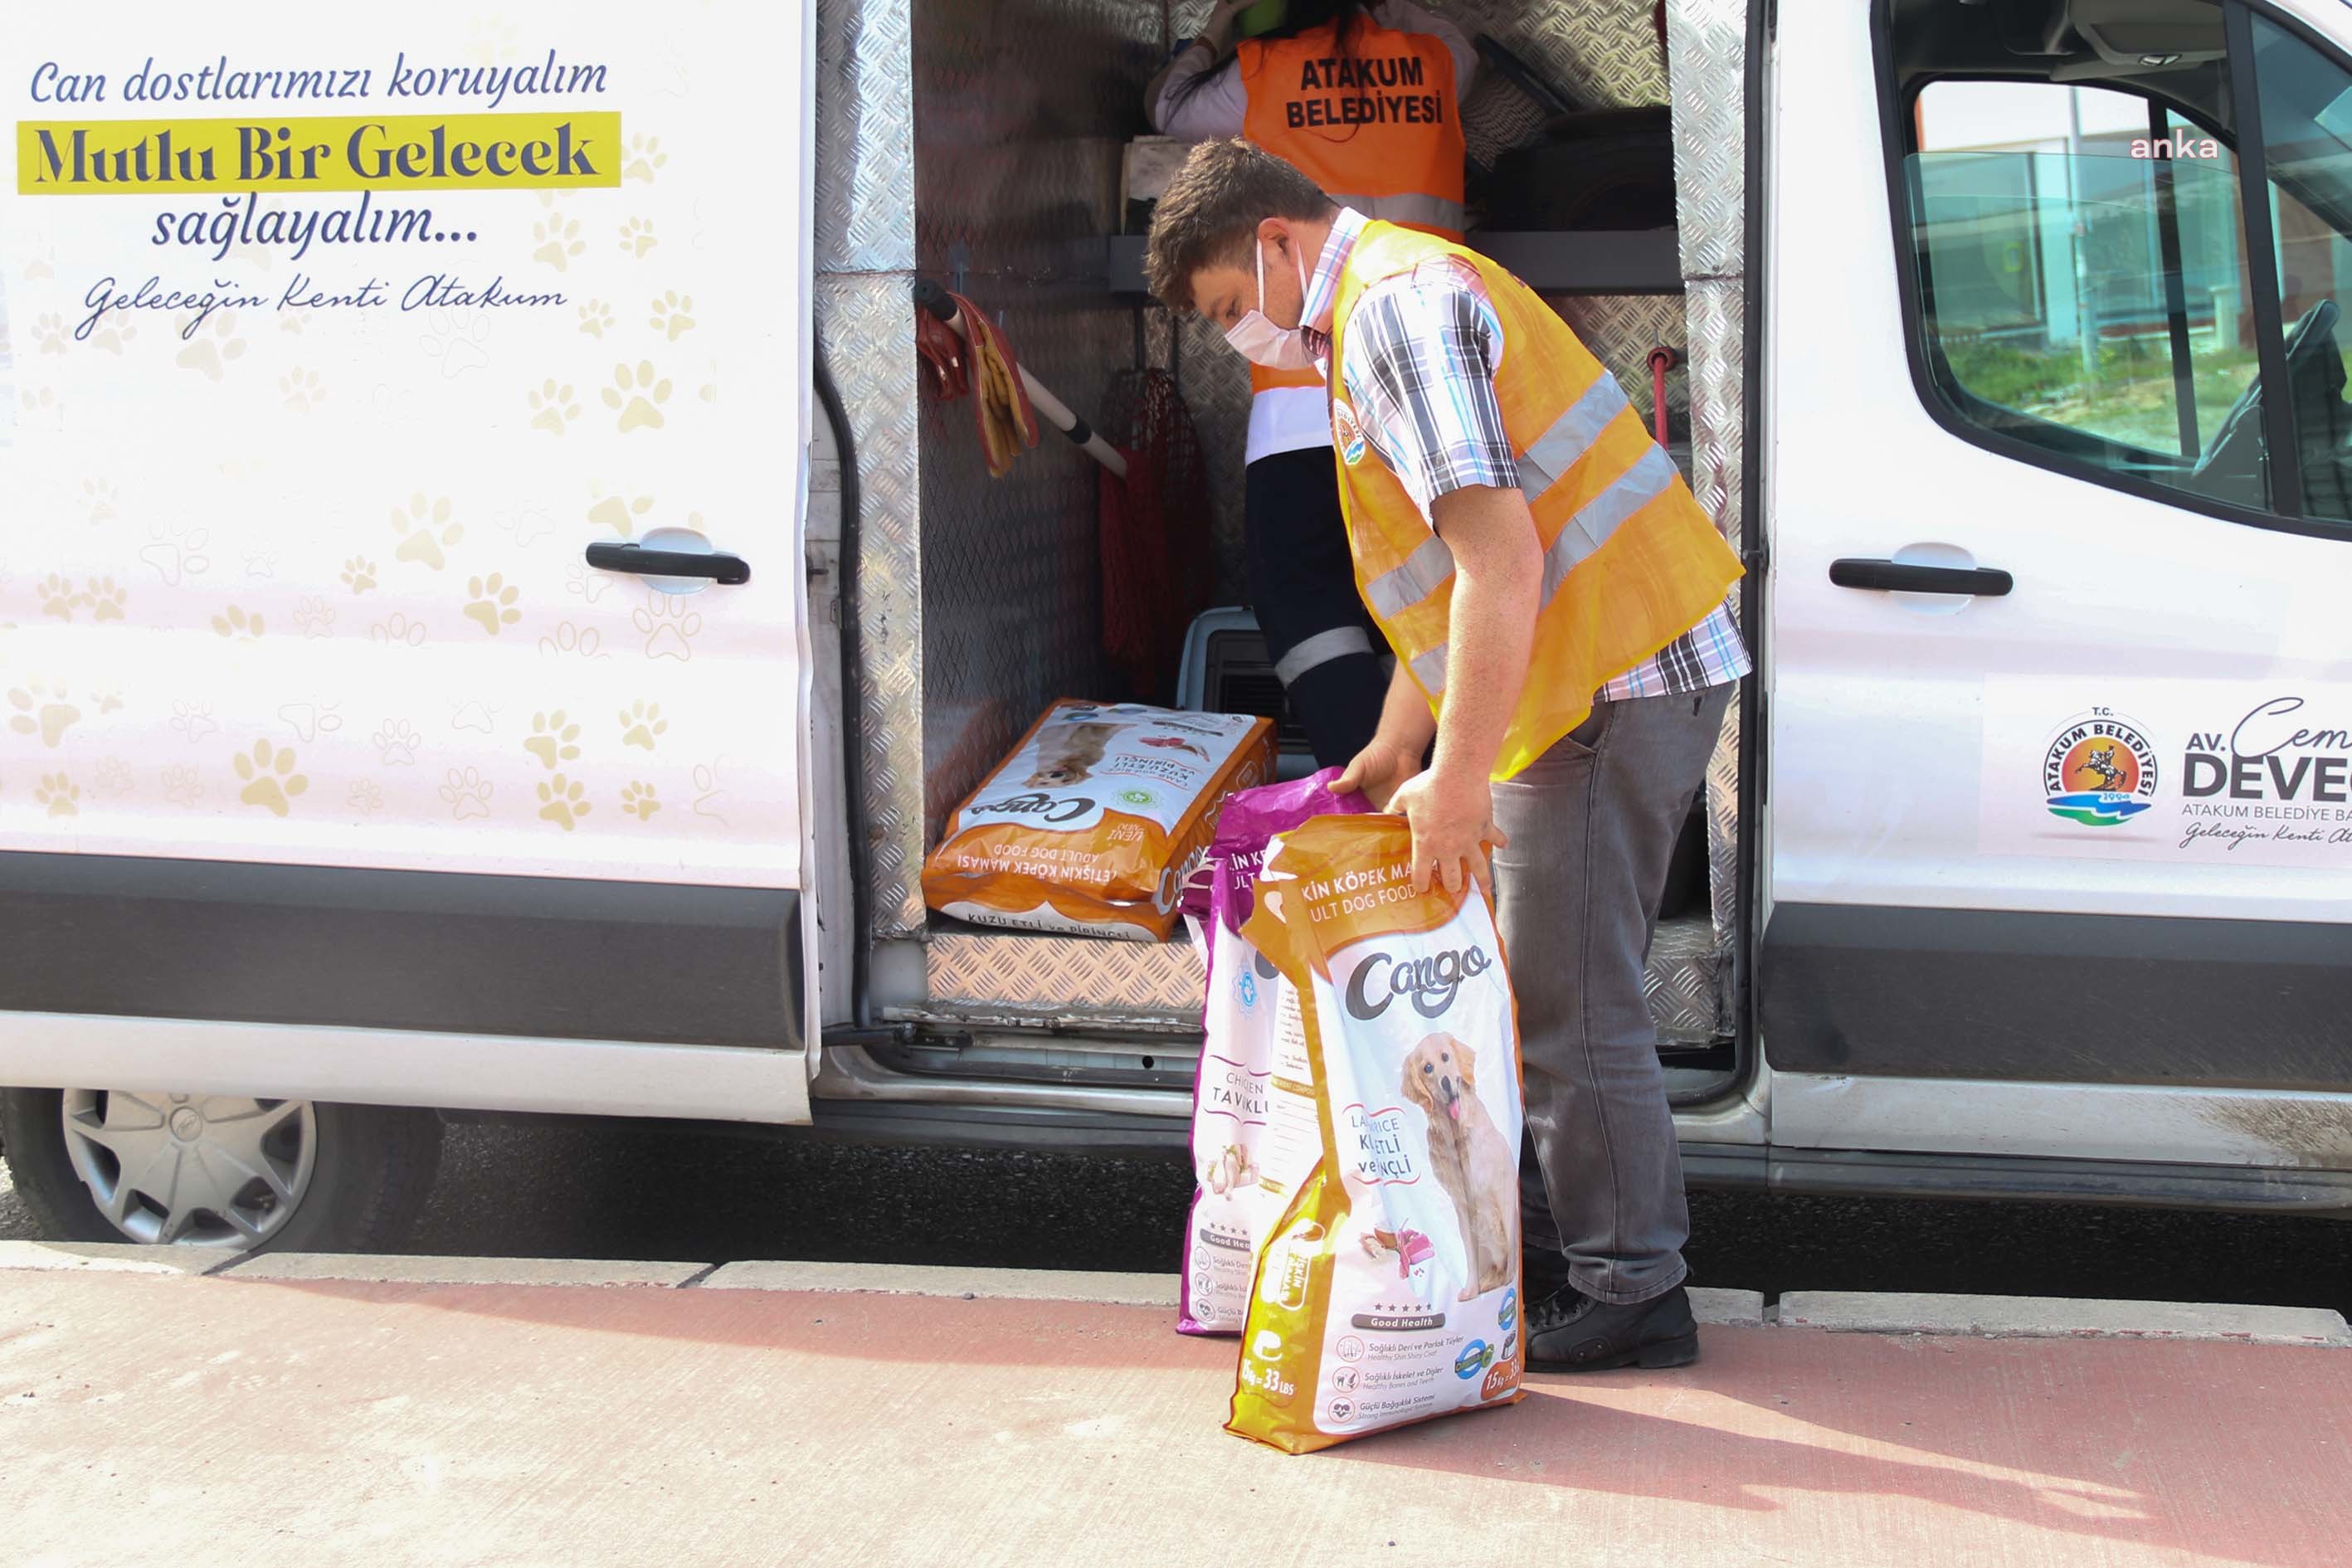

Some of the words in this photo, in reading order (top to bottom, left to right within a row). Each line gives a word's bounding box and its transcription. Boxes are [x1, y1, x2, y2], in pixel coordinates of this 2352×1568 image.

[31, 61, 107, 102] Can
[123, 56, 370, 101] dostlarımızı
[387, 49, 607, 109] koruyalım
[1300, 56, 1424, 90] ATAKUM
[1286, 90, 1443, 129] BELEDİYESİ
[34, 128, 218, 183] Mutlu
[235, 126, 332, 181] Bir
[346, 121, 601, 178] Gelecek
[151, 190, 478, 261] sağlayalım...
[75, 276, 269, 341] Geleceğin
[276, 274, 388, 312] Kenti
[401, 275, 567, 312] Atakum
[2091, 707, 2114, 716] T.C.
[2185, 733, 2226, 752] AV.
[2230, 697, 2352, 758] Cem
[2048, 728, 2087, 791] ATAKUM
[2183, 752, 2352, 802] DEVE
[2181, 803, 2248, 818] ATAKUM
[2254, 806, 2330, 821] BELEDİYE
[2179, 821, 2269, 850] Geleceğin
[2272, 825, 2325, 841] Kenti
[957, 855, 1010, 874] MAMASI
[994, 844, 1026, 857] FOOD
[1031, 848, 1057, 860] DOG
[1060, 850, 1099, 864] ADULT
[1014, 860, 1057, 880] KÖPEK
[1334, 868, 1387, 894] KÖPEK
[1342, 894, 1376, 914] DOG
[1378, 884, 1417, 906] FOOD
[968, 913, 1006, 926] KUZU
[1346, 945, 1492, 1020] Cango
[1210, 1235, 1230, 1245] Good
[1371, 1317, 1398, 1327] Good
[1402, 1317, 1433, 1327] Health
